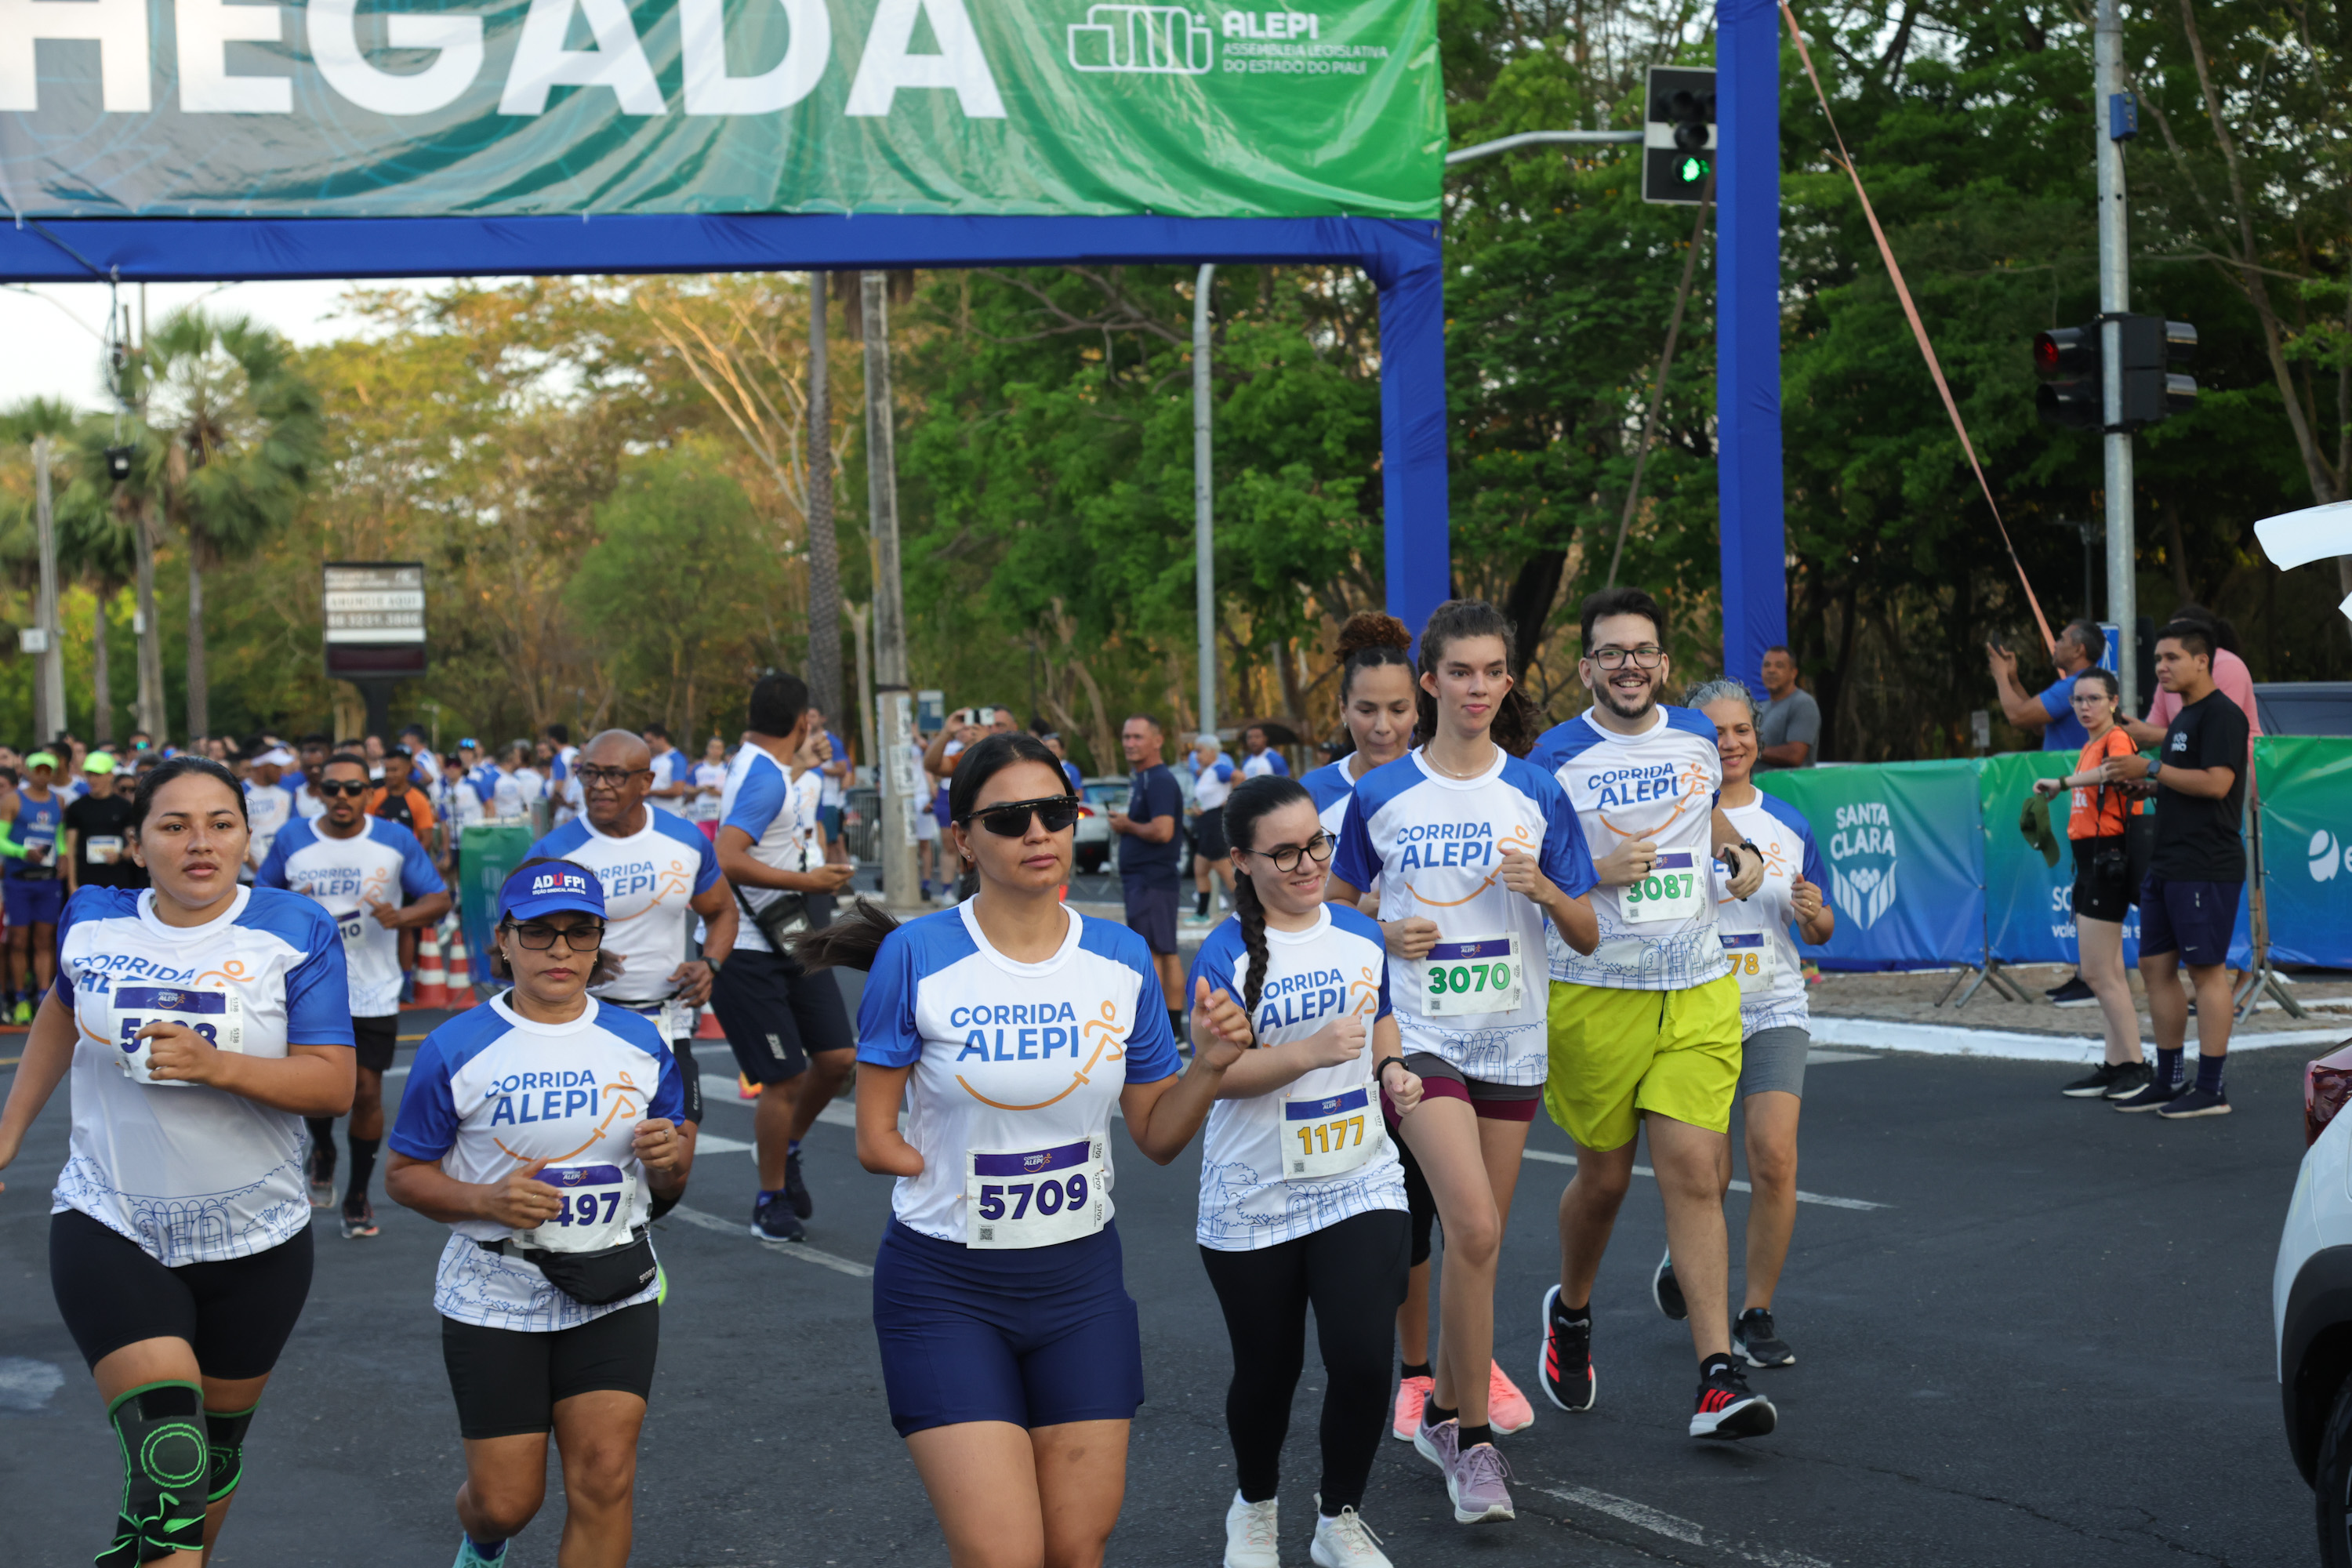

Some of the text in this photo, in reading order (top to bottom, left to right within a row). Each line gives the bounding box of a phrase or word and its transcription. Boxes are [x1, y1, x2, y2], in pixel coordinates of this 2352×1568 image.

[1221, 10, 1319, 39] ALEPI
[1221, 43, 1389, 59] ASSEMBLEIA LEGISLATIVA
[1222, 59, 1245, 73] DO
[1248, 59, 1305, 74] ESTADO
[1306, 60, 1329, 74] DO
[1588, 763, 1675, 789] CORRIDA
[1597, 776, 1679, 809] ALEPI
[1835, 802, 1890, 829] SANTA
[1396, 822, 1493, 845] CORRIDA
[1830, 826, 1896, 861] CLARA
[1400, 840, 1493, 873] ALEPI
[299, 867, 361, 881] CORRIDA
[532, 872, 586, 891] ADUFPI
[1626, 873, 1693, 902] 3087
[74, 954, 196, 985] CORRIDA
[1428, 963, 1510, 994] 3070
[1258, 968, 1344, 1003] ORRIDA
[950, 1002, 1076, 1028] CORRIDA
[1258, 986, 1346, 1034] ALEPI
[956, 1025, 1079, 1062] ALEPI
[485, 1069, 596, 1098] CORRIDA
[490, 1088, 598, 1127] ALEPI
[1298, 1115, 1364, 1155] 1177
[541, 1192, 621, 1227] 497
[978, 1174, 1088, 1221] 5709
[639, 1266, 656, 1283] SPORT
